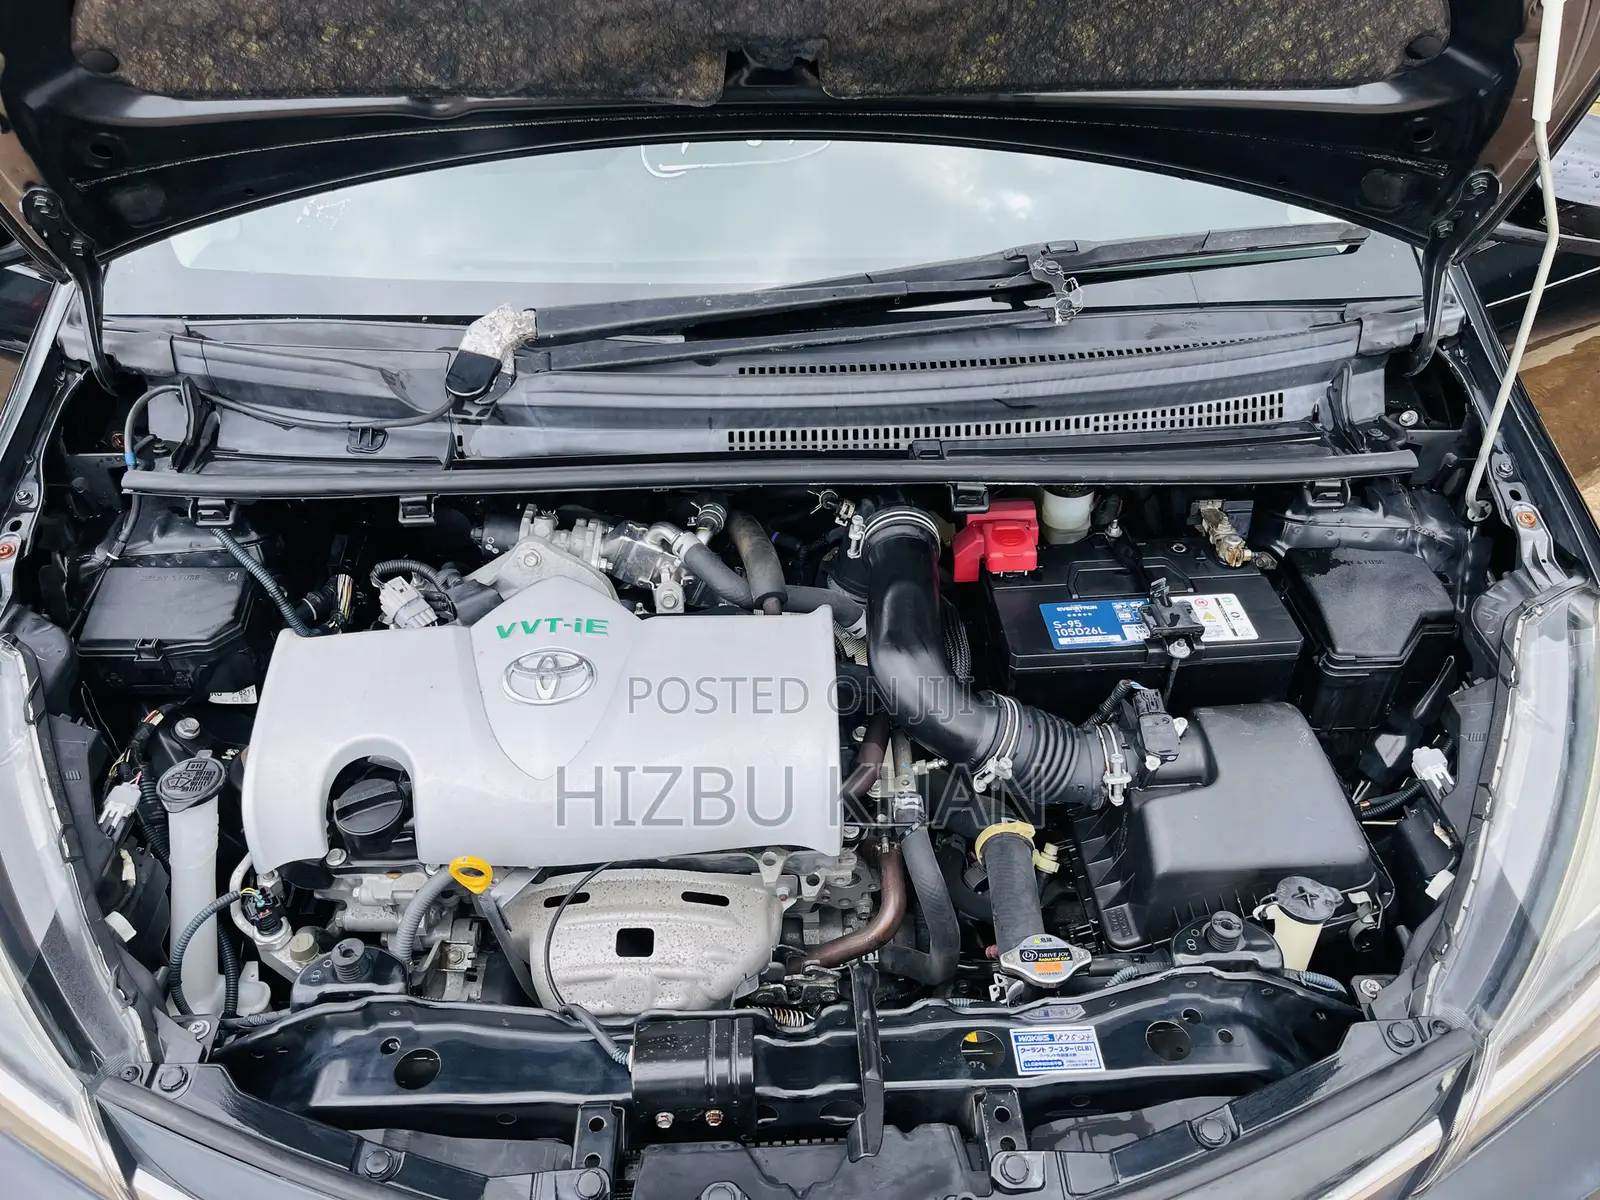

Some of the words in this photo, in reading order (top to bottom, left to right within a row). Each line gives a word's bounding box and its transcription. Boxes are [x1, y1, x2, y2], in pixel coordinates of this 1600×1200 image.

[496, 617, 609, 639] VVT-iE
[1052, 620, 1082, 629] S-95
[1055, 627, 1107, 636] 105D26L
